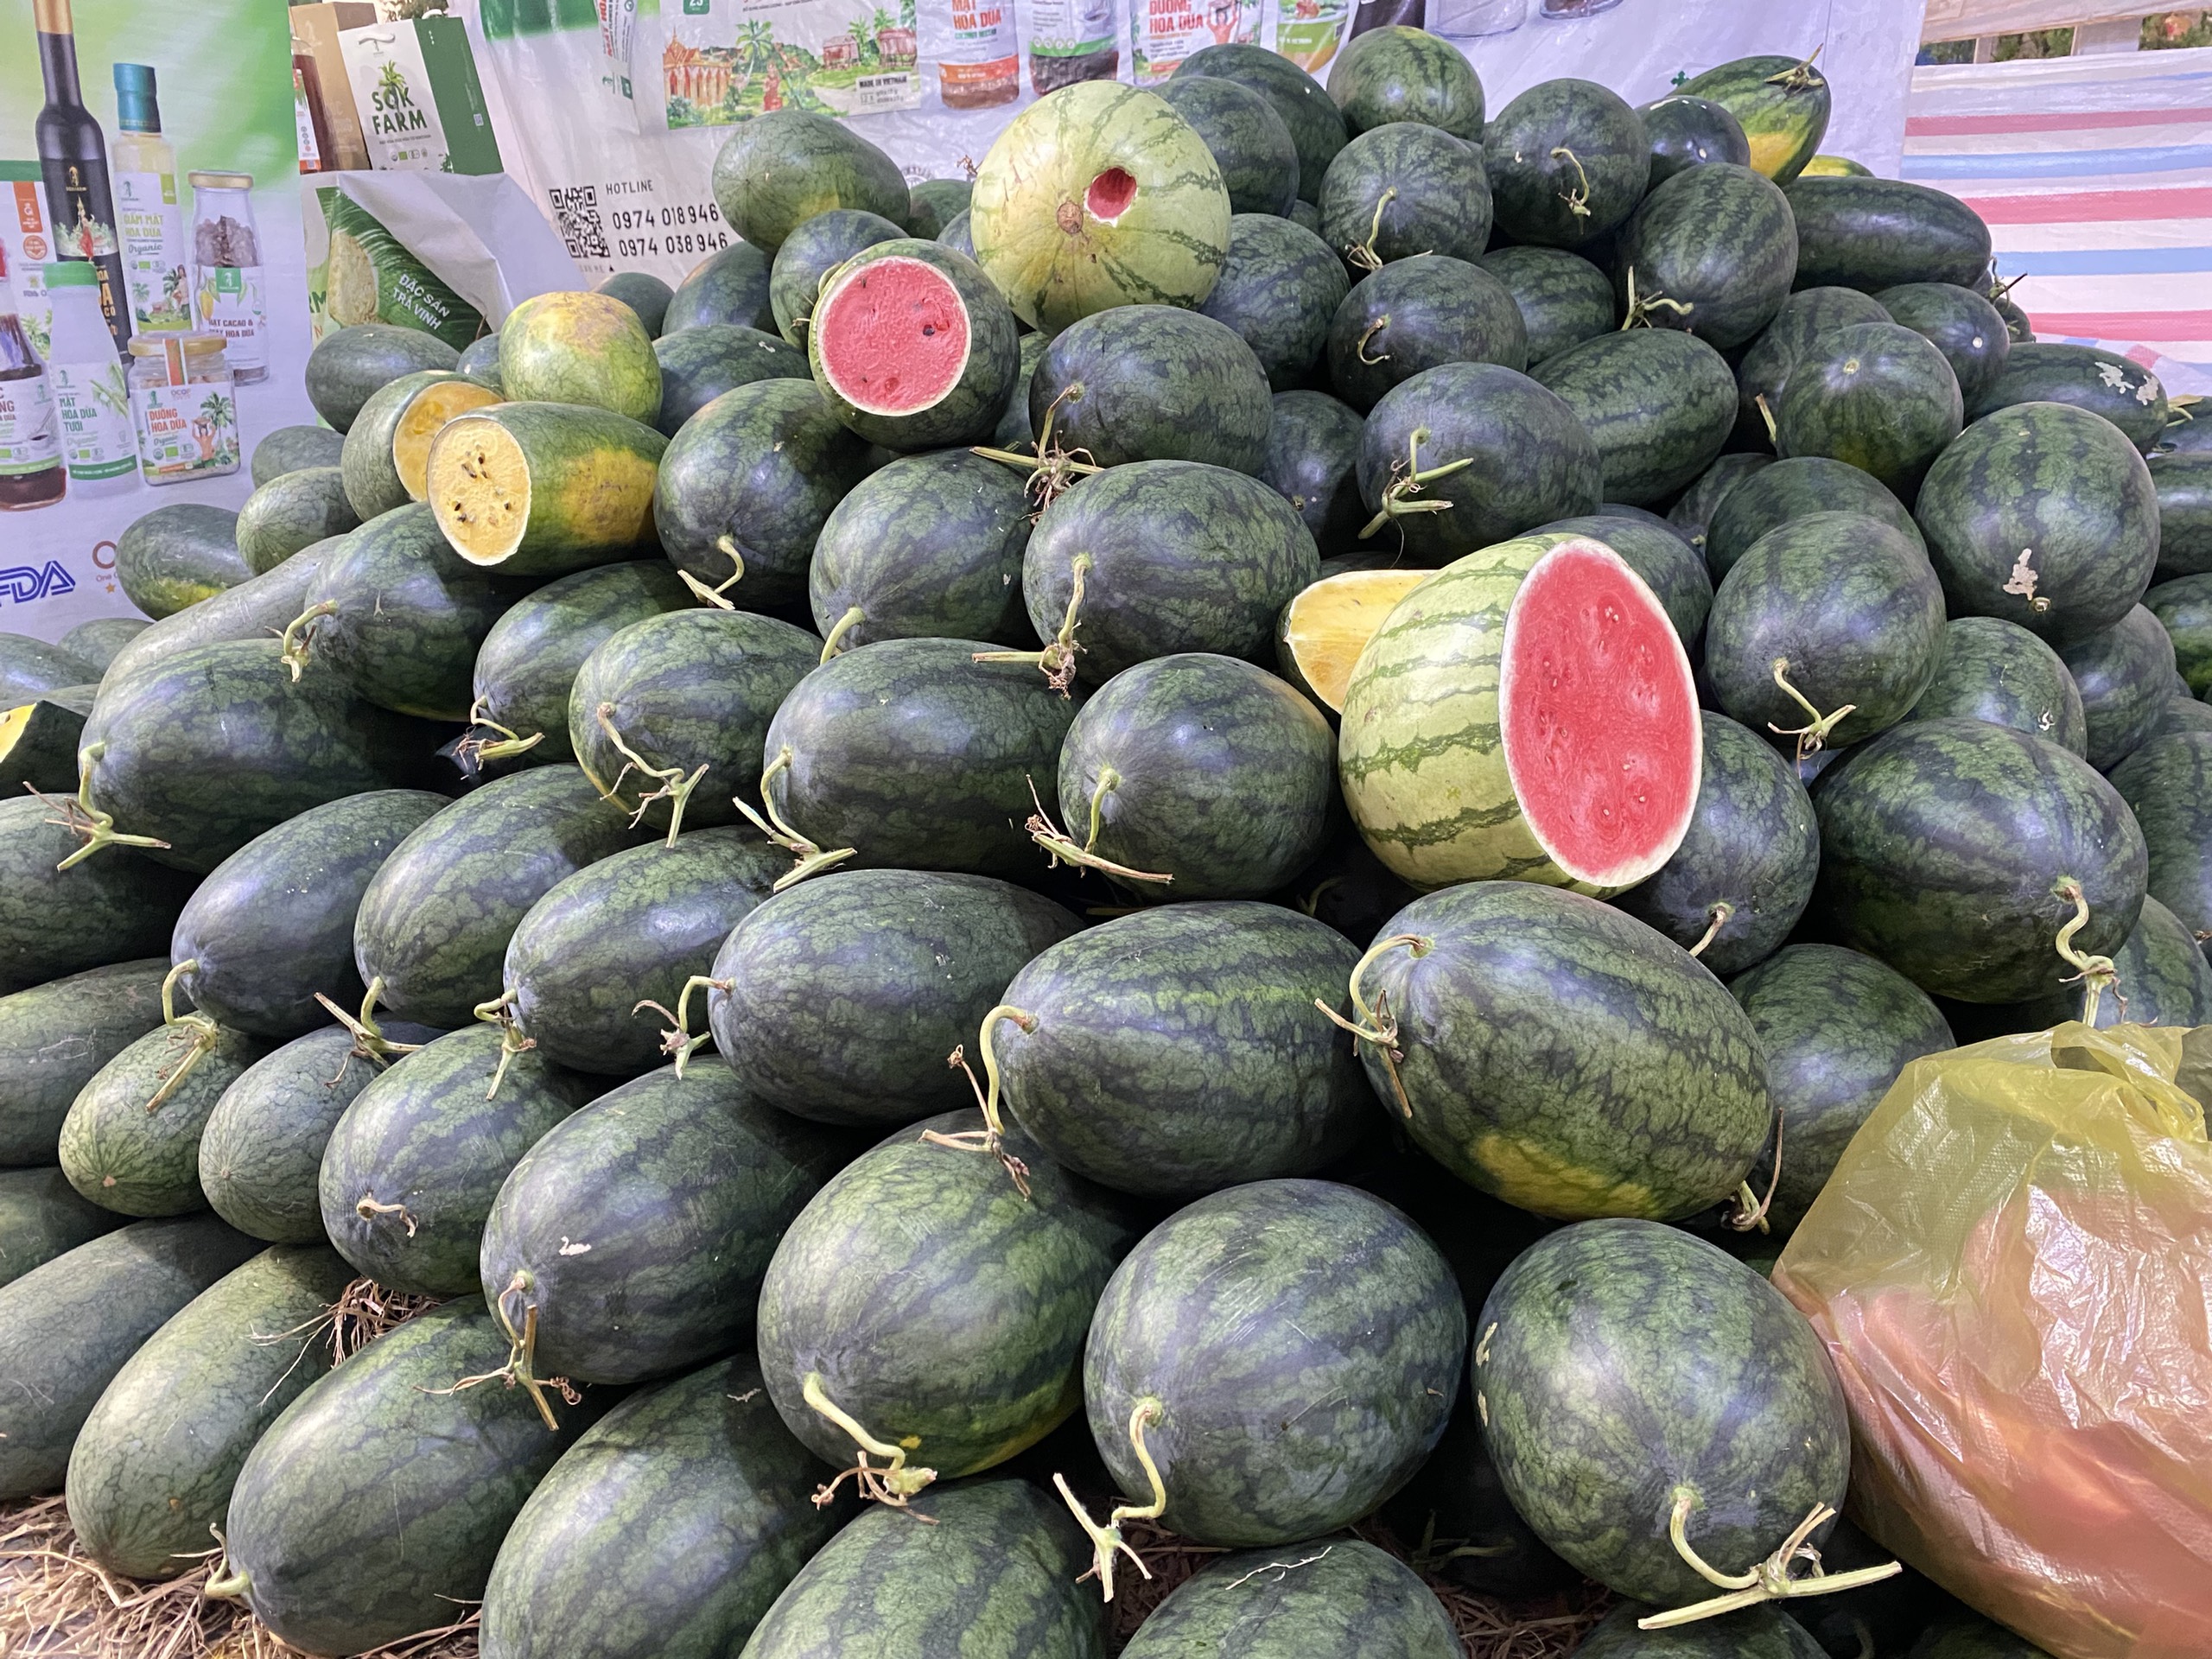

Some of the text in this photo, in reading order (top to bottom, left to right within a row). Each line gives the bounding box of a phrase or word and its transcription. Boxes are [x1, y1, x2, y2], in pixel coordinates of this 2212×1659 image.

[953, 13, 977, 31] HOA
[1149, 15, 1175, 35] HOA
[371, 85, 415, 112] SOK
[371, 108, 429, 136] FARM
[606, 179, 654, 195] HOTLINE
[612, 209, 655, 230] 0974
[128, 242, 162, 255] Organic
[619, 238, 658, 257] 0974
[398, 273, 425, 298] ĐẶC
[223, 319, 246, 327] CACAO
[414, 303, 442, 331] VINH
[61, 410, 79, 420] HOA
[150, 422, 168, 433] HOA
